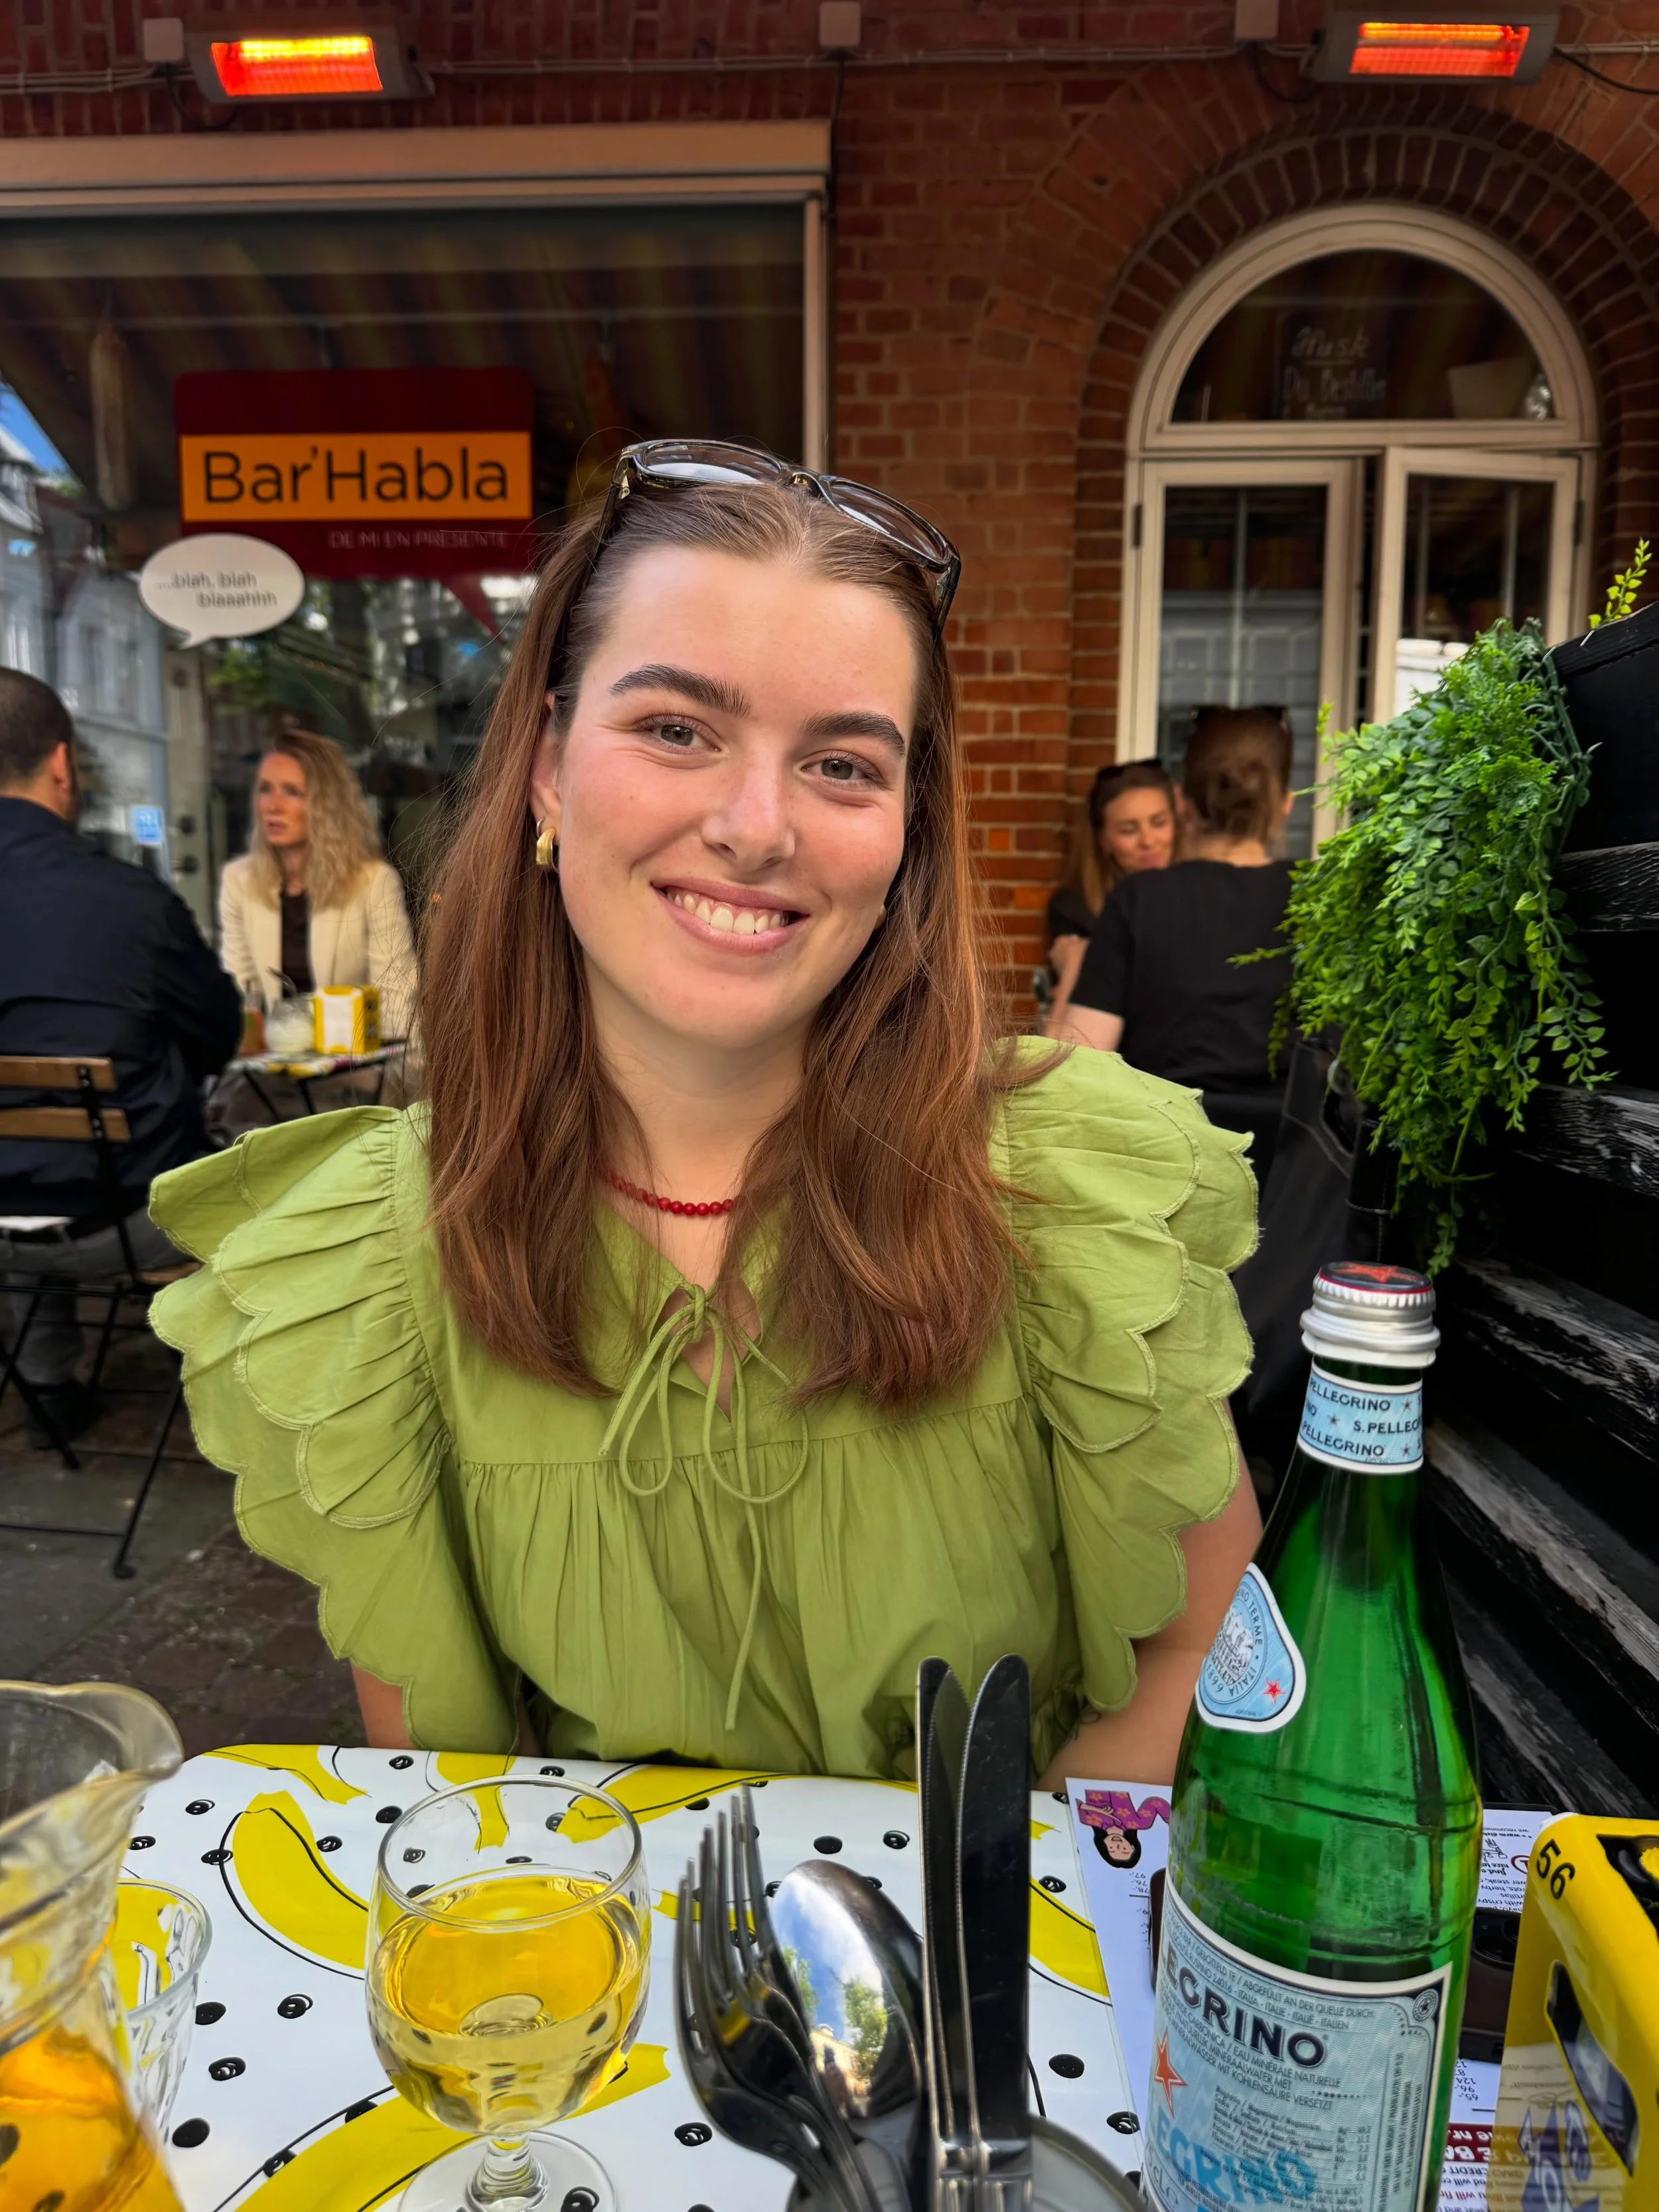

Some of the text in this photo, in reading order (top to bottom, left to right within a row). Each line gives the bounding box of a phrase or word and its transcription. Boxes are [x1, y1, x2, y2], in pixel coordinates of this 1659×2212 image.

[204, 445, 509, 504] Bar'Habla
[216, 570, 257, 588] blah
[1309, 1378, 1392, 1411] PELLEGRINO
[1303, 1421, 1385, 1456] PELLEGRINO
[1248, 1600, 1263, 1646] TERME
[1536, 1838, 1576, 1900] 56
